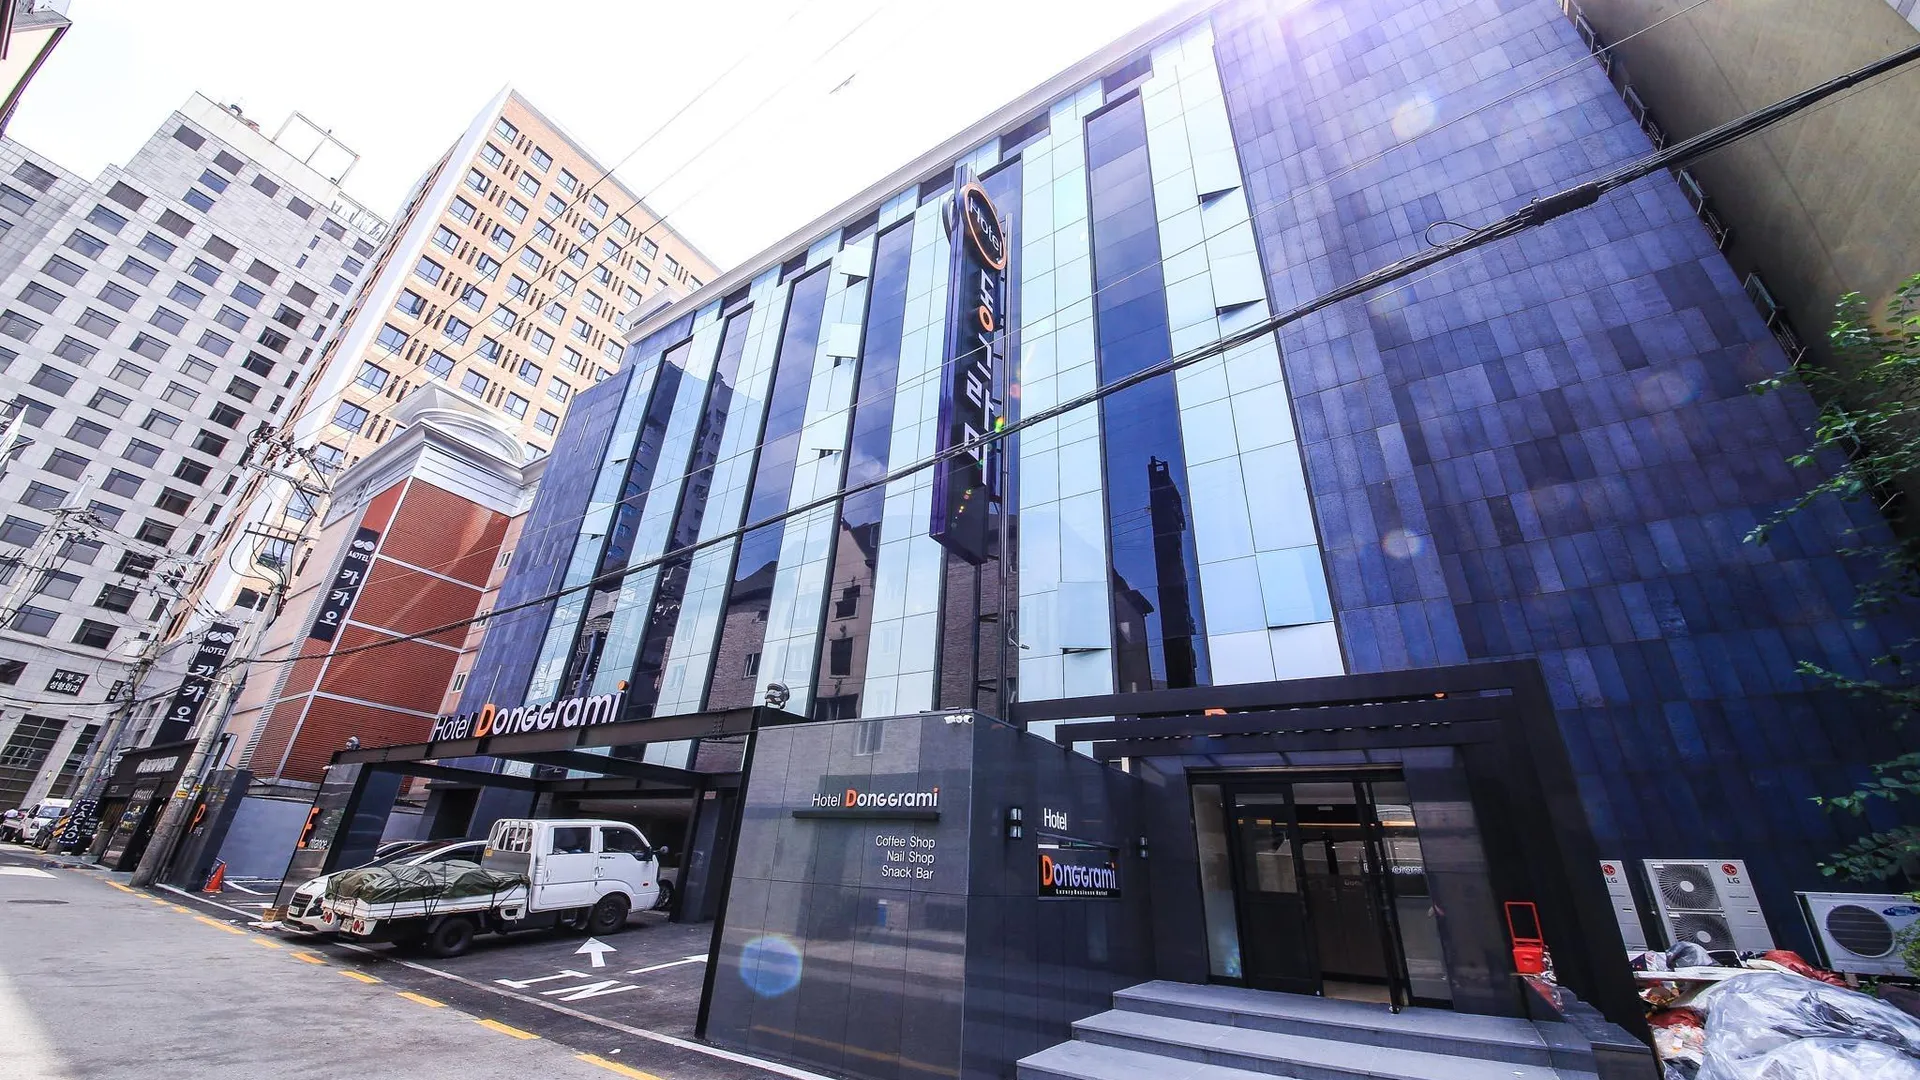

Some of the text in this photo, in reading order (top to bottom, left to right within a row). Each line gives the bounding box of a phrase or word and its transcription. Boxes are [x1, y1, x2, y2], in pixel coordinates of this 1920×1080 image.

[970, 197, 1002, 256] Hotel
[348, 551, 369, 562] MOTEL
[319, 569, 360, 626] 카카오
[200, 645, 227, 656] MOTEL
[169, 664, 215, 722] 카카오
[429, 715, 473, 742] Hotel
[811, 793, 841, 807] Hotel
[65, 803, 91, 839] CACAO
[1043, 807, 1068, 831] Hotel
[875, 835, 936, 850] Coffee Shop
[886, 850, 935, 865] Nail Shop
[881, 865, 934, 879] Snack Bar
